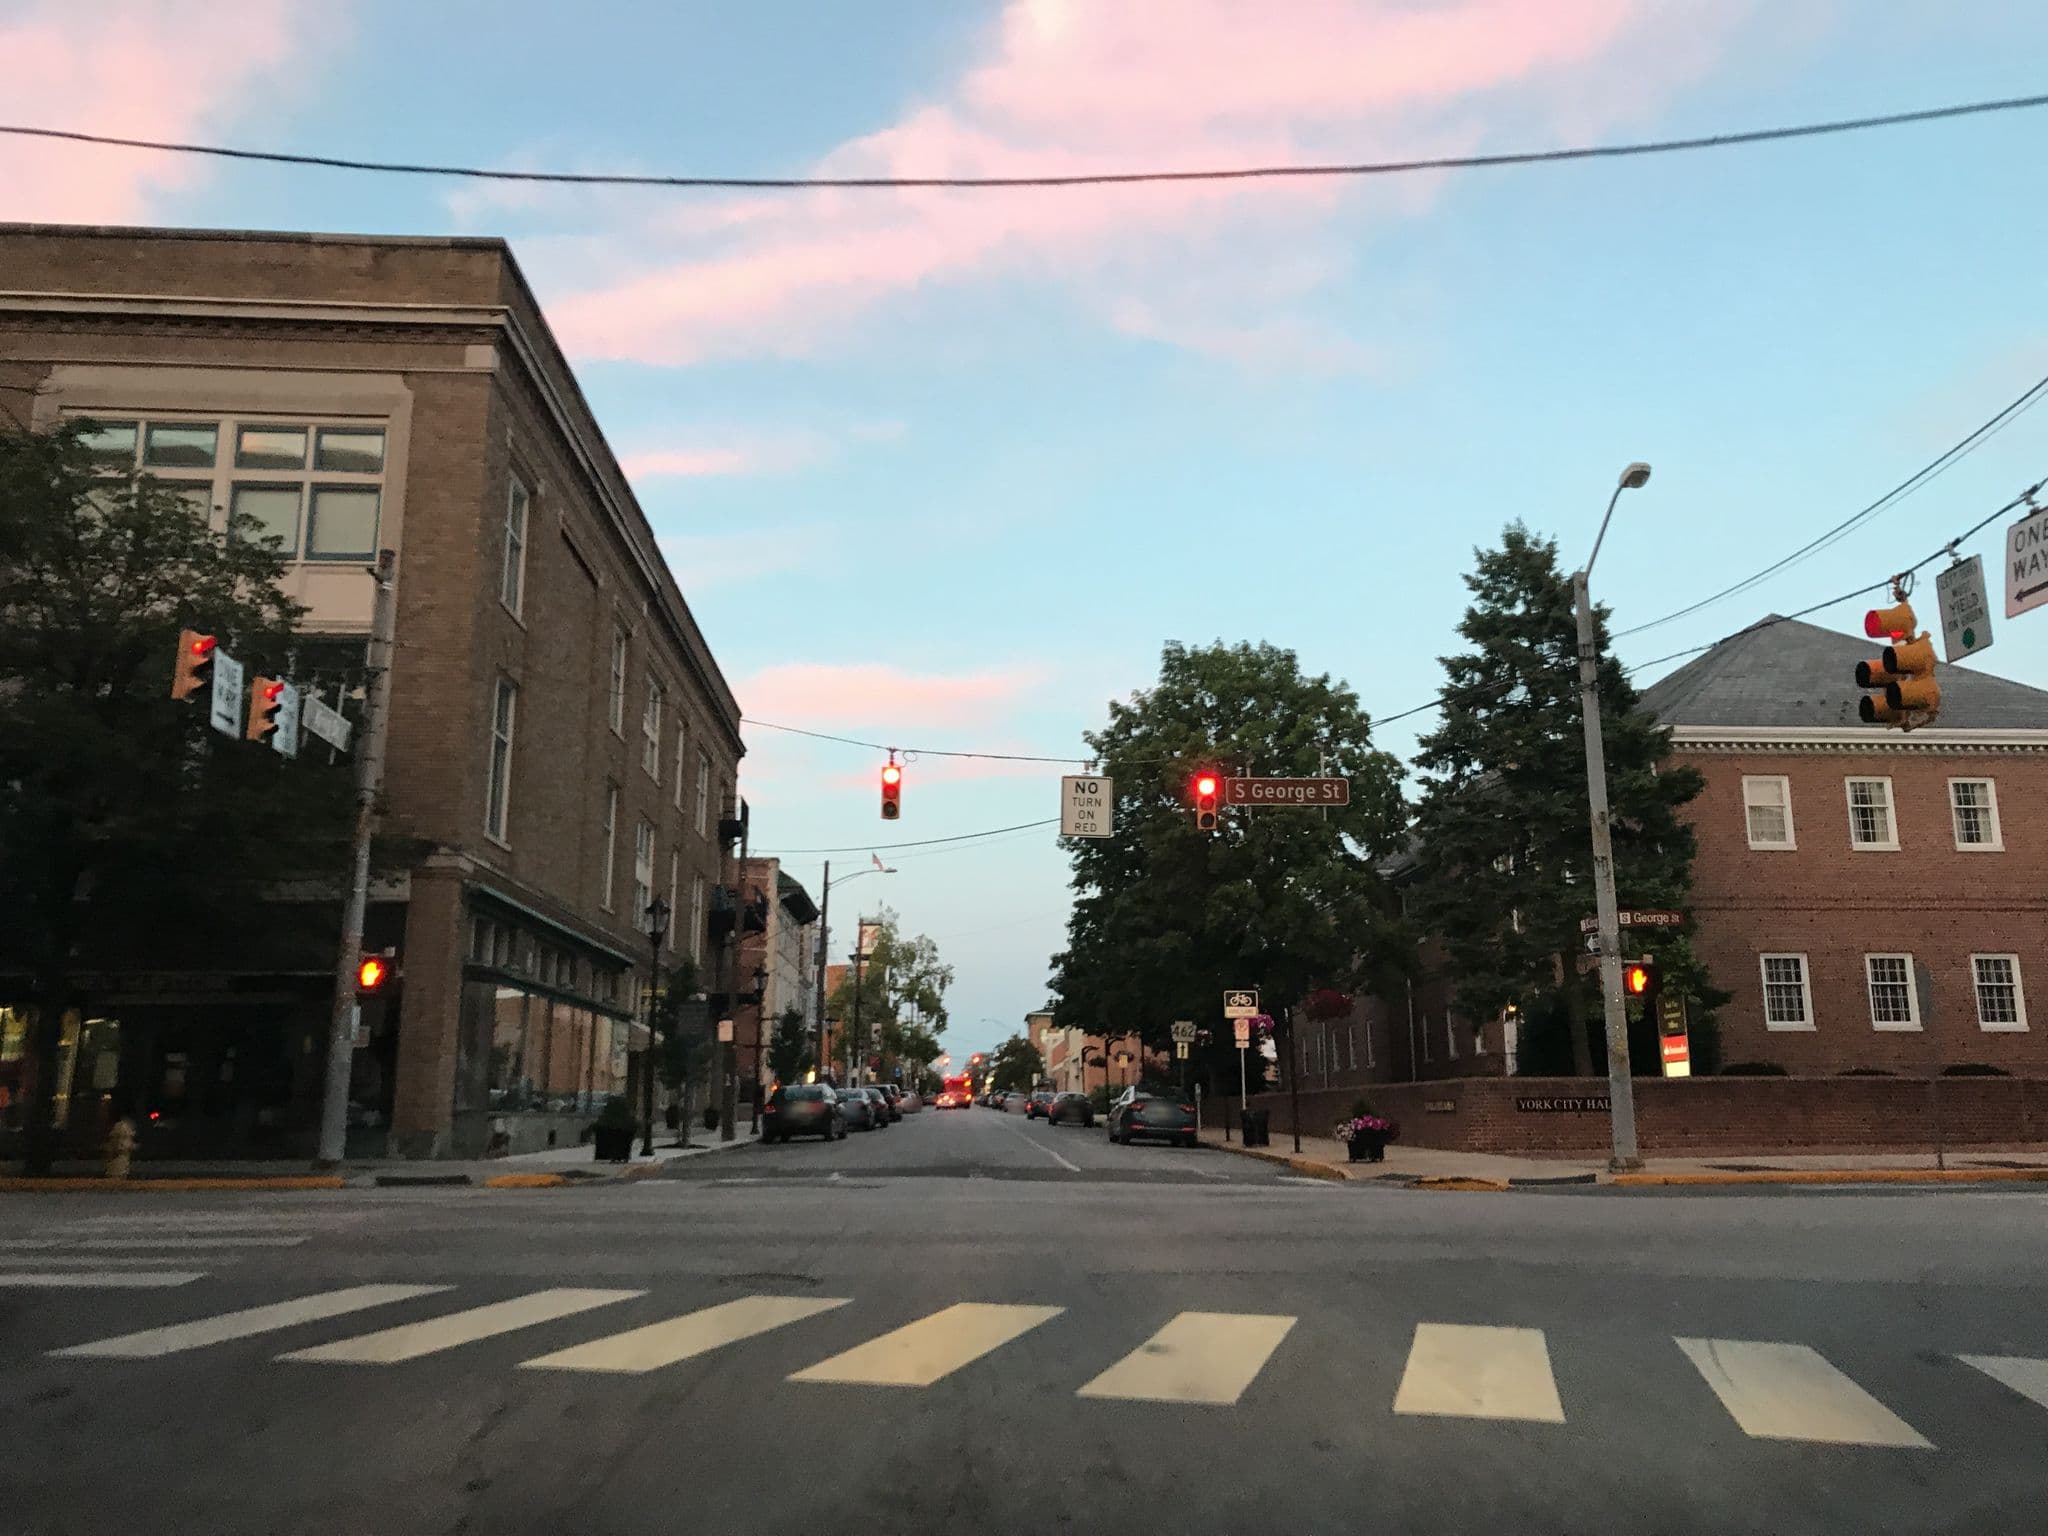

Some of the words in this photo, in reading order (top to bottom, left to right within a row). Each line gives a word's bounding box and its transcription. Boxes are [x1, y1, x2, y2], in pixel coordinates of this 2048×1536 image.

[1075, 781, 1098, 794] NO
[1235, 783, 1246, 798] S
[1251, 783, 1316, 802] George
[1322, 783, 1340, 799] St
[1072, 797, 1102, 807] TURN
[1078, 809, 1095, 820] ON
[1074, 822, 1098, 832] RED
[1633, 912, 1669, 925] George
[1671, 914, 1680, 923] St
[1172, 1025, 1193, 1038] 462
[1519, 1099, 1552, 1110] YORK
[1553, 1099, 1583, 1110] CITY
[1586, 1099, 1613, 1110] HAL
